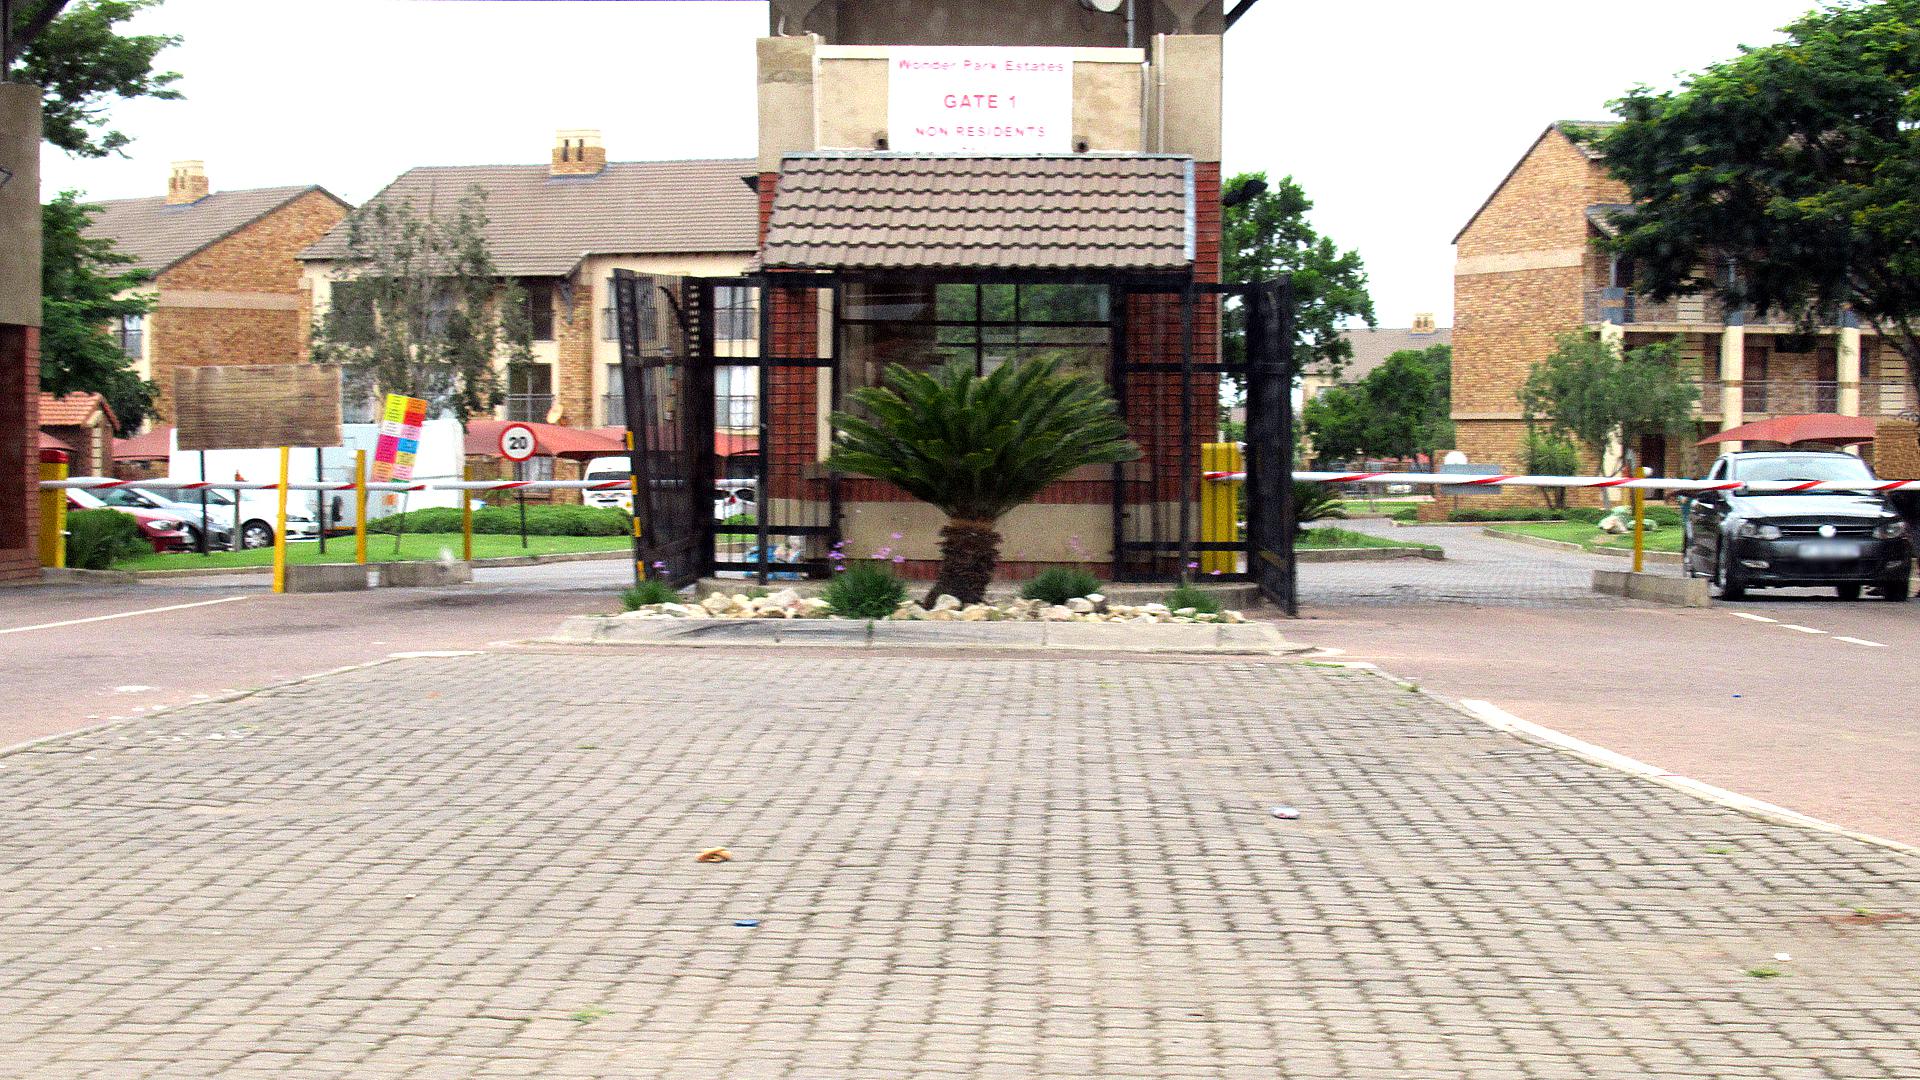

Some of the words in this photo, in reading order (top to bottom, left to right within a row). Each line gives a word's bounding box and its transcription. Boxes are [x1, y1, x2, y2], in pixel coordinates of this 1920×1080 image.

[899, 59, 956, 70] Wonder
[963, 59, 997, 71] Park
[1005, 60, 1064, 72] Estates
[943, 94, 998, 109] GATE
[1009, 95, 1016, 108] 1
[915, 126, 948, 137] NON
[956, 126, 1046, 137] RESIDENTS
[508, 436, 528, 450] 20
